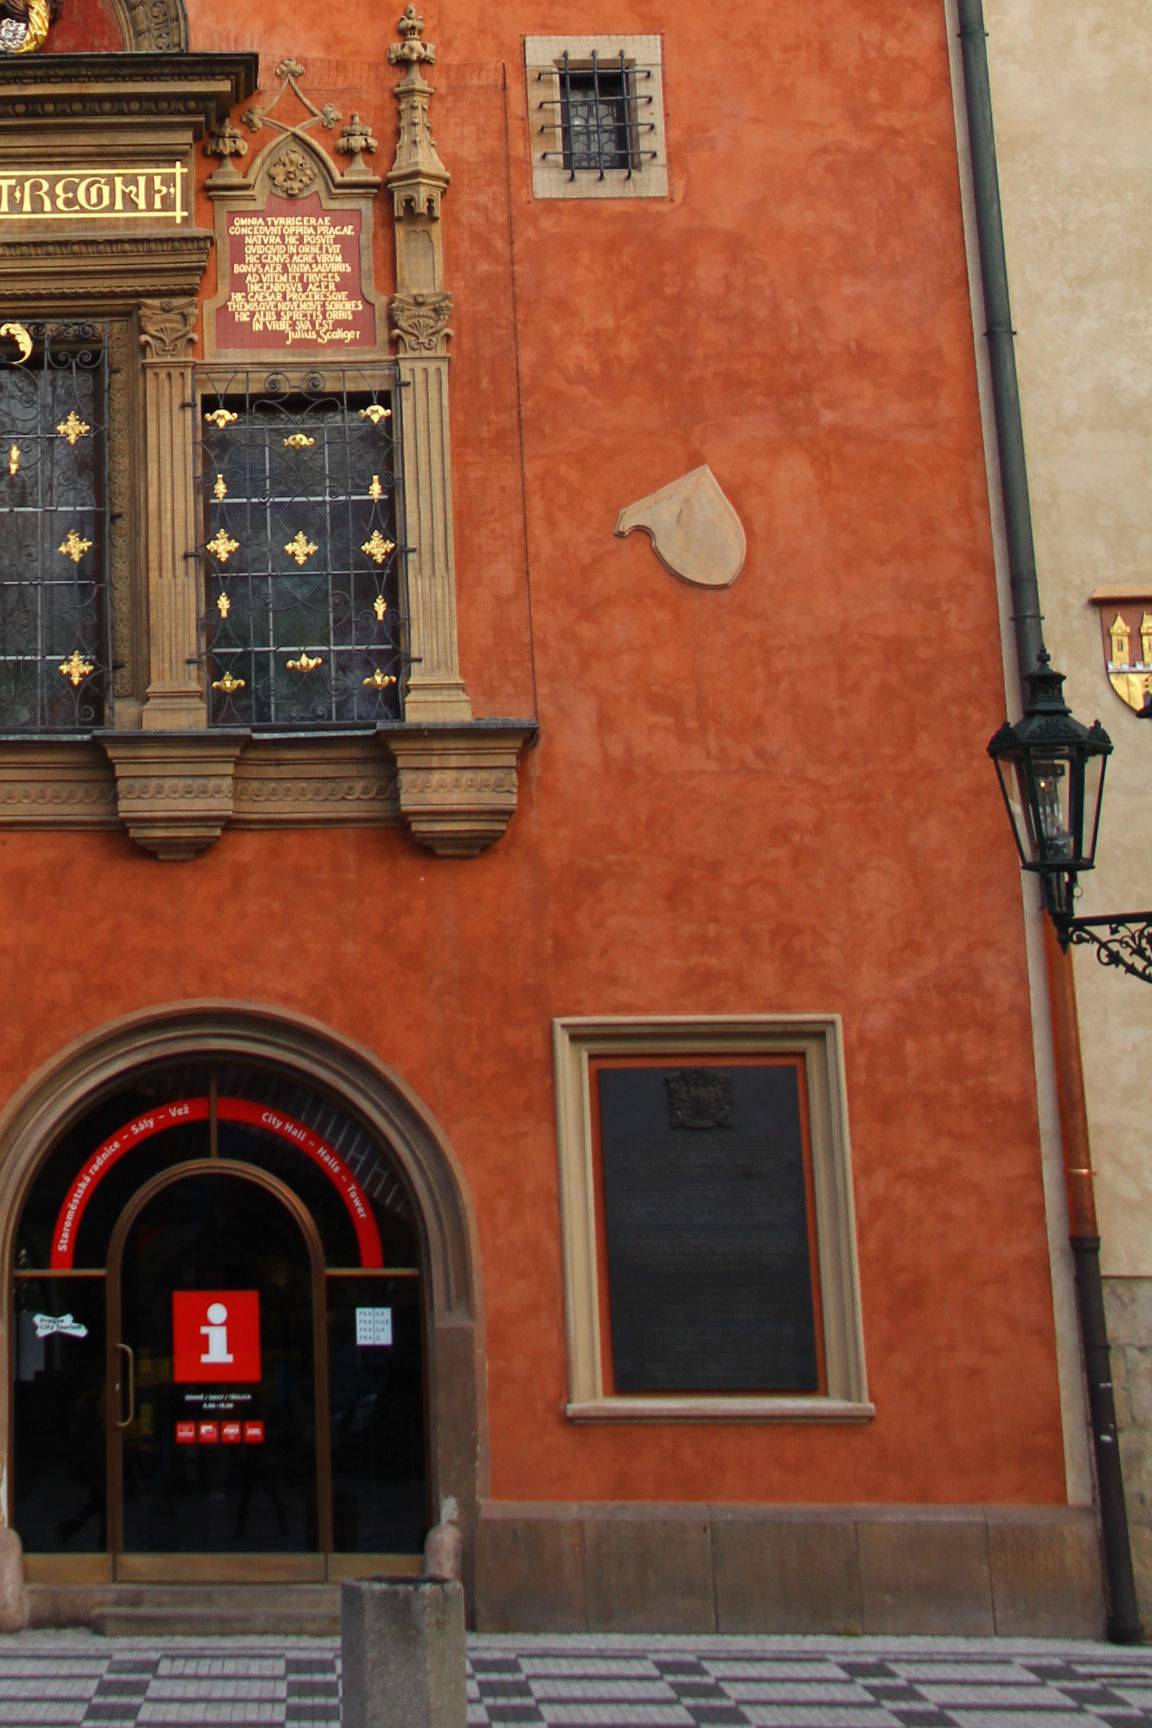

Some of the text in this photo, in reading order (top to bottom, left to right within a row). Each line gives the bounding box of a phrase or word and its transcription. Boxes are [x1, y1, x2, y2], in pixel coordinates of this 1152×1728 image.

[234, 217, 265, 225] OMNIA
[229, 226, 282, 235] CONCEDVNT
[283, 226, 315, 235] OPPIDA
[245, 235, 335, 244] NATVRA HIC POSVIT
[288, 245, 297, 254] IN
[245, 254, 260, 263] HIC
[233, 264, 263, 273] BONVS
[264, 264, 282, 273] AER
[287, 264, 312, 273] VNDA
[245, 274, 259, 283] AD
[288, 273, 300, 283] ET
[231, 293, 246, 302] HIC
[248, 292, 282, 301] CAESAR
[234, 312, 250, 322] HIC
[280, 311, 323, 320] SPRETIS
[326, 310, 353, 320] ORBIS
[252, 320, 334, 331] IN VRBE SVA EST
[285, 328, 360, 344] Julius Scaliger
[89, 1140, 121, 1175] radnice
[261, 1112, 283, 1129] City
[284, 1122, 307, 1142] Hall
[316, 1146, 341, 1173] Halls
[347, 1184, 367, 1218] Tower
